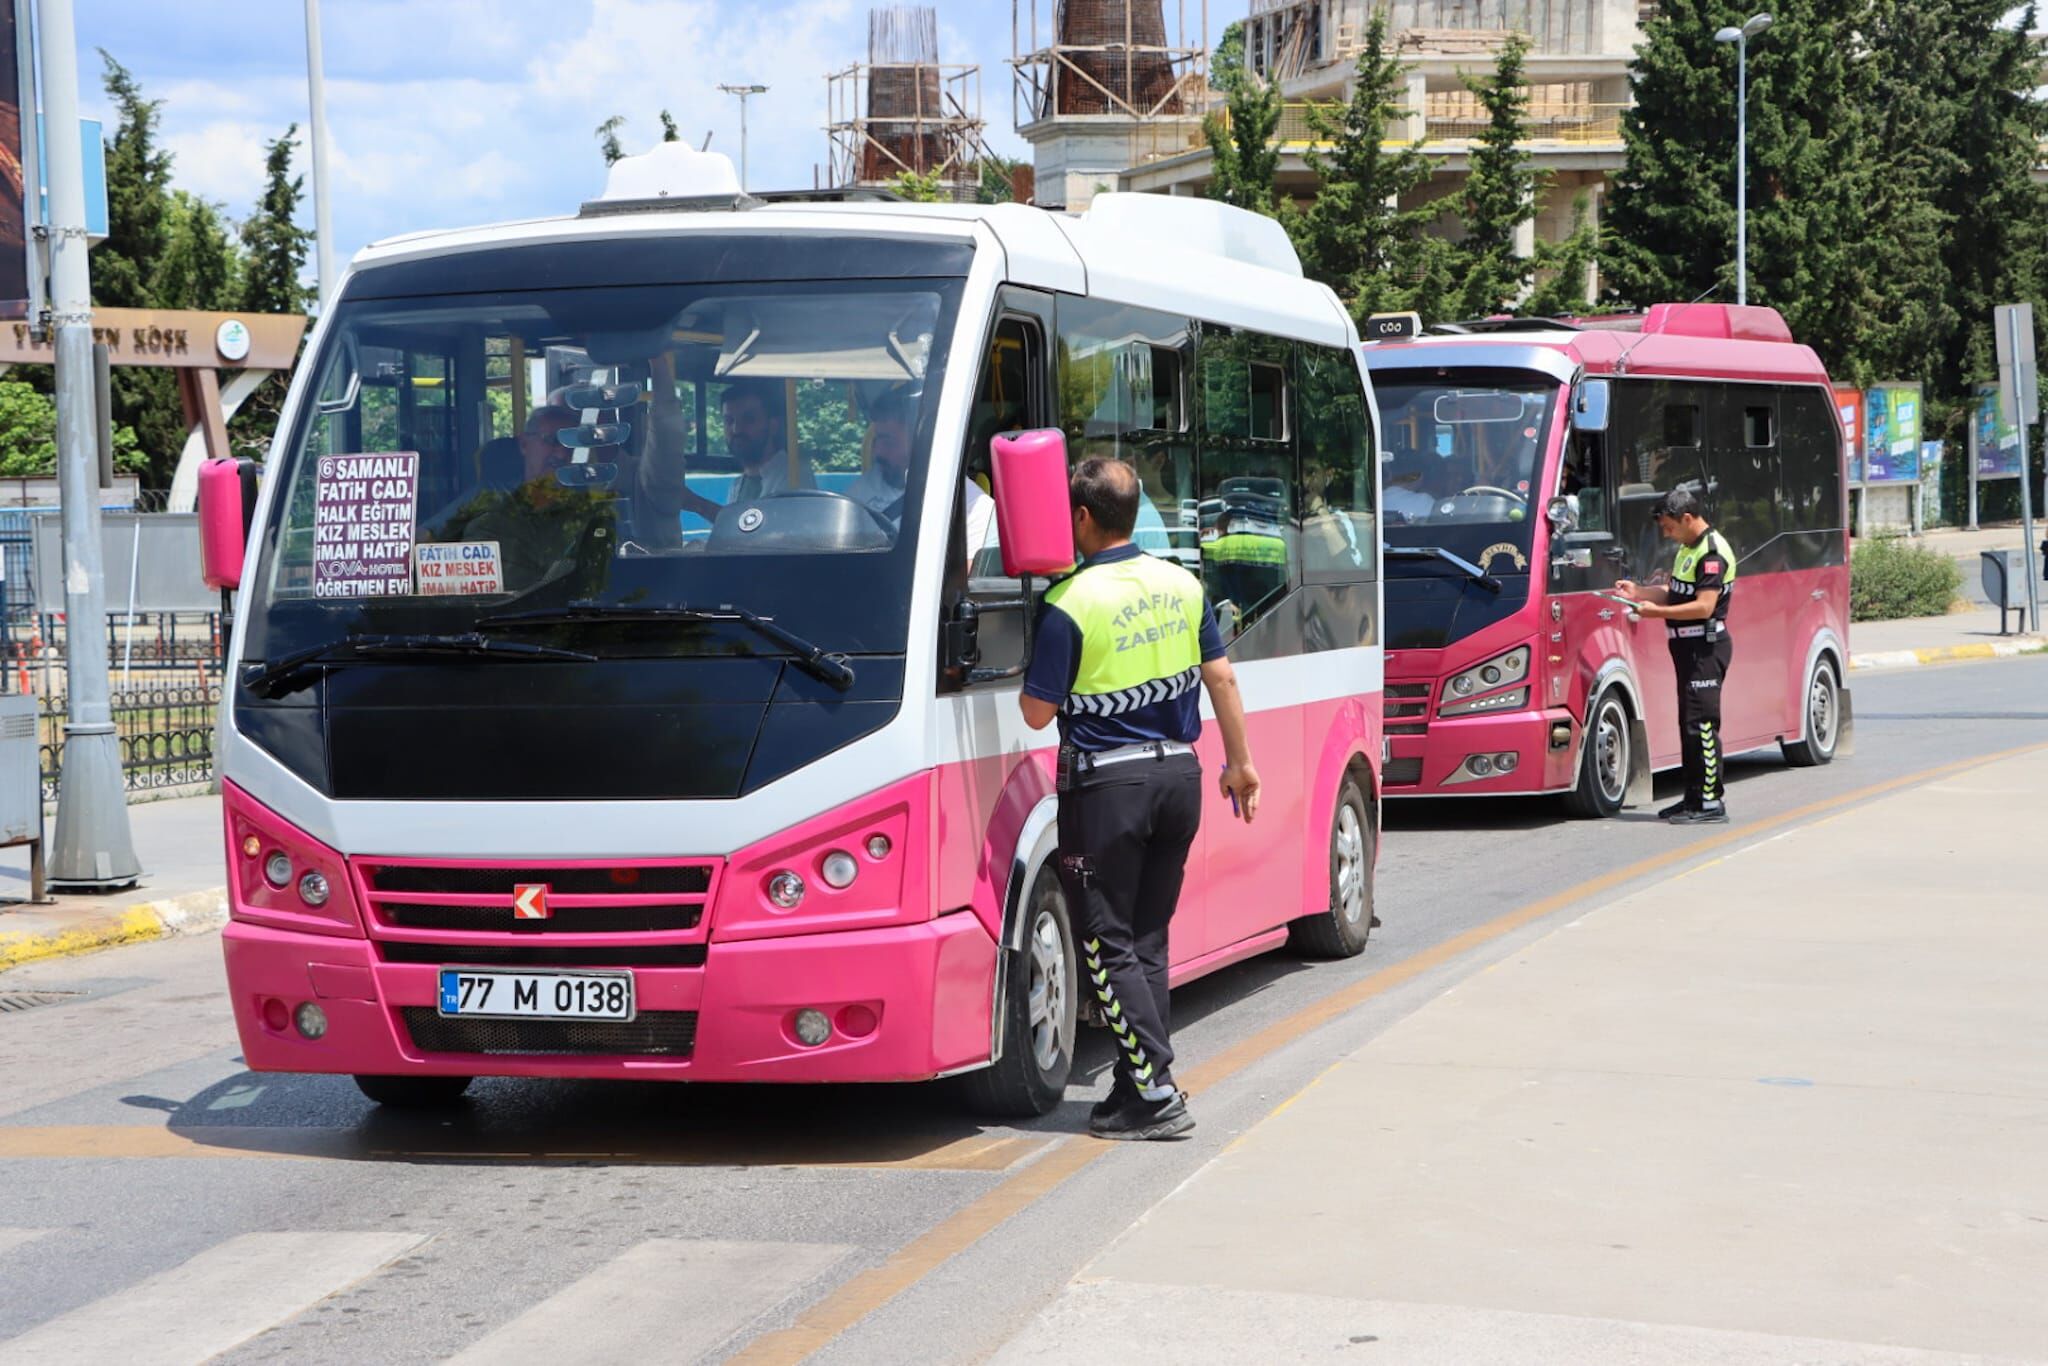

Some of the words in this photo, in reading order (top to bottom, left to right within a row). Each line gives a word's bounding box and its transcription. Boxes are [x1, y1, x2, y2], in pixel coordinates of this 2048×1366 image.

[336, 457, 414, 480] SAMANLI
[371, 479, 412, 499] CAD.
[318, 505, 359, 523] HALK
[318, 524, 344, 542] KIZ
[347, 522, 410, 541] MESLEK
[462, 545, 496, 560] CAD.
[368, 563, 406, 576] HOTEL
[421, 563, 442, 577] KIZ
[445, 561, 496, 577] MESLEK
[315, 578, 384, 597] ÖĞRETMEN
[1115, 618, 1190, 653] ZABITA
[445, 994, 458, 1004] TR
[459, 977, 495, 1010] 77
[513, 979, 539, 1011] M
[555, 980, 625, 1014] 0138
